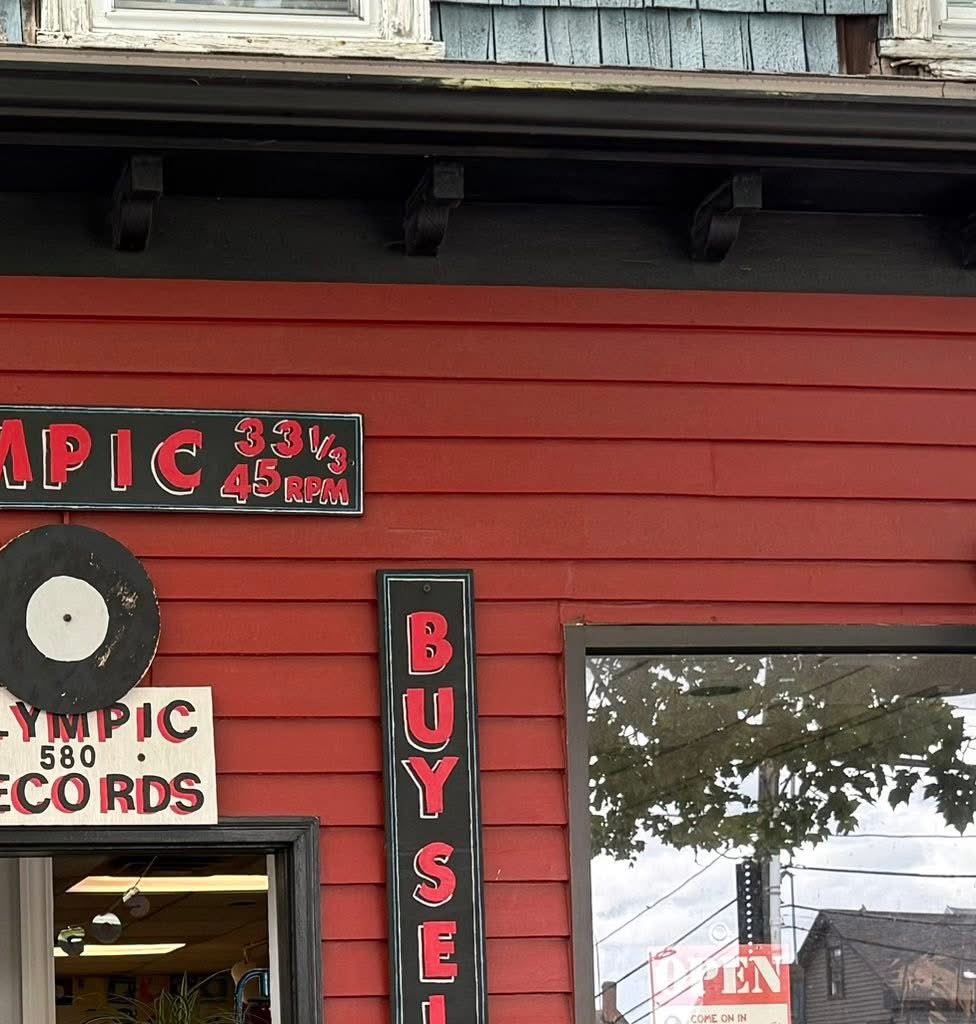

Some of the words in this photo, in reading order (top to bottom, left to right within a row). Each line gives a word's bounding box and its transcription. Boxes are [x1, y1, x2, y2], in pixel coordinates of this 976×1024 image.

[234, 417, 304, 458] 33
[220, 459, 282, 503] 45
[284, 475, 349, 505] RPM
[401, 611, 460, 819] BUY
[39, 745, 97, 769] 580
[654, 956, 781, 994] OPEN
[690, 1014, 717, 1024] COME
[721, 1014, 734, 1023] ON
[737, 1013, 747, 1023] IN
